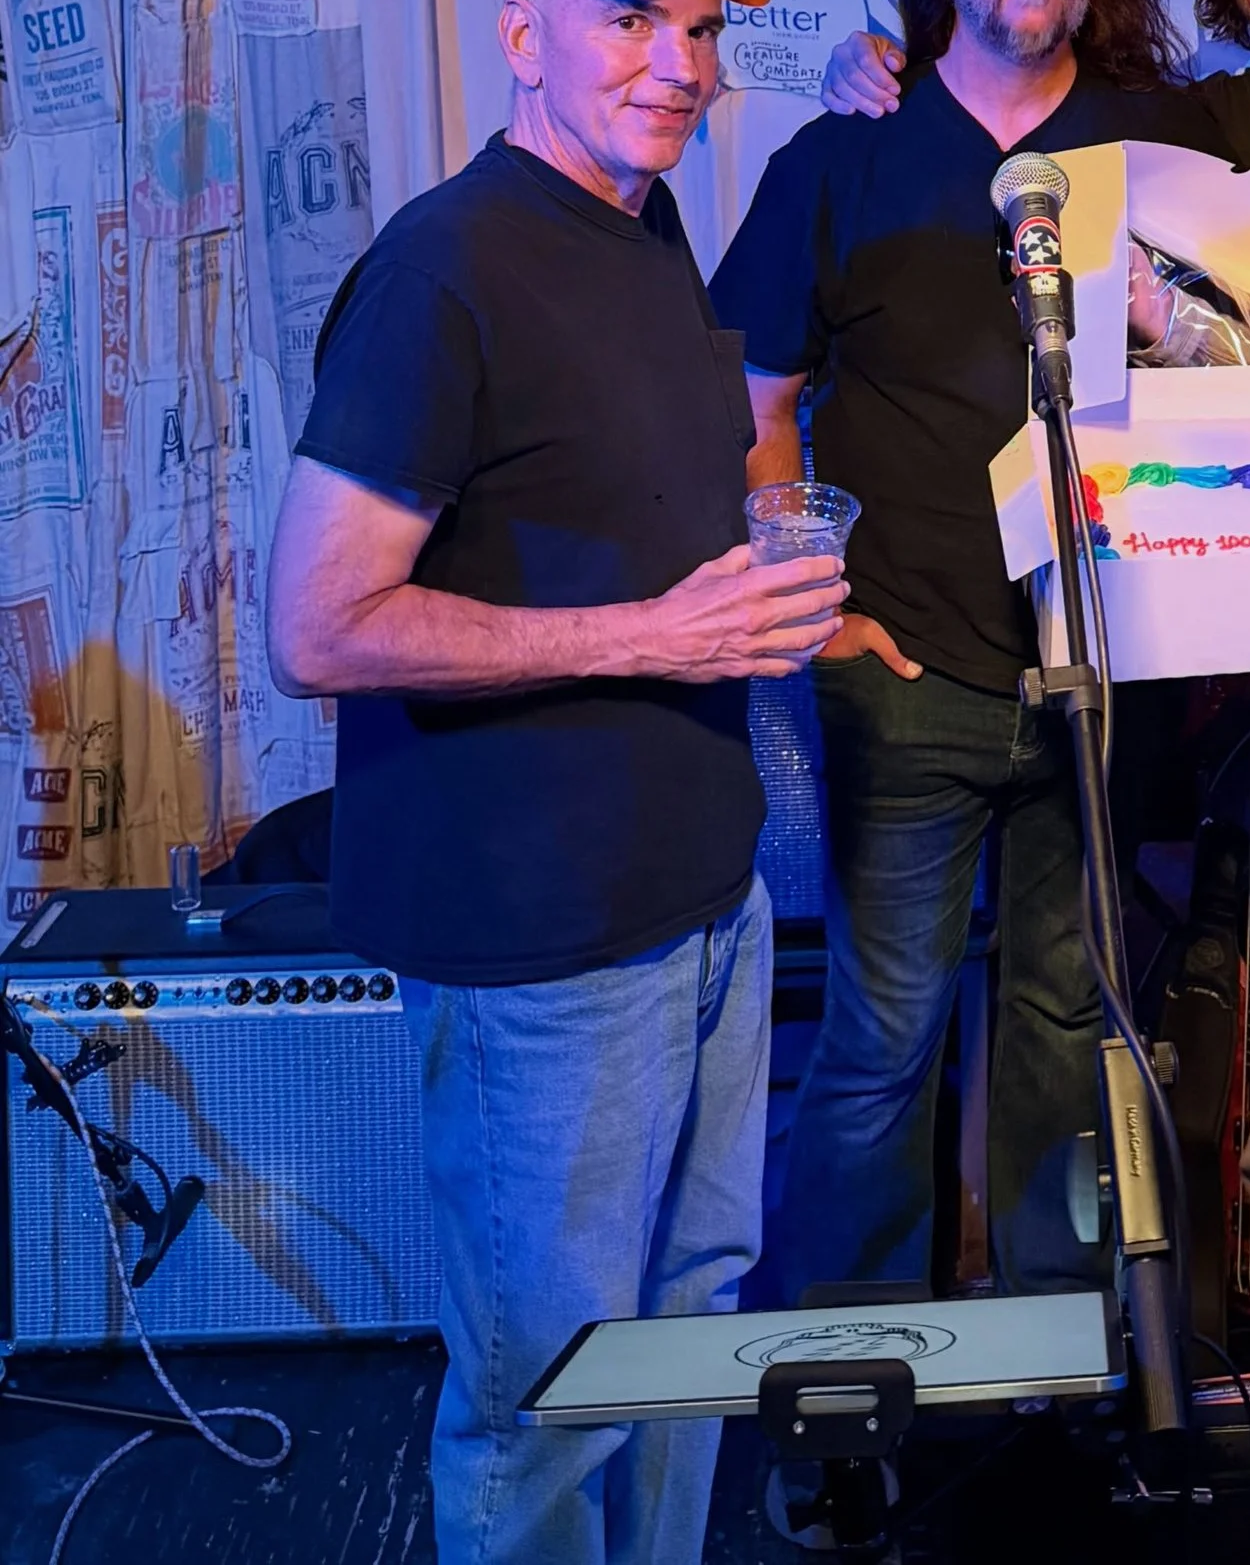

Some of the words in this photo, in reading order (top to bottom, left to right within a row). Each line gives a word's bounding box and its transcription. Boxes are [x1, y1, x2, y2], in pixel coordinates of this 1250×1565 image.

[23, 2, 86, 54] SEED
[726, 0, 828, 33] Better
[734, 42, 799, 69] CREATURE
[751, 60, 823, 82] COMFORTS
[1123, 532, 1209, 556] Happy
